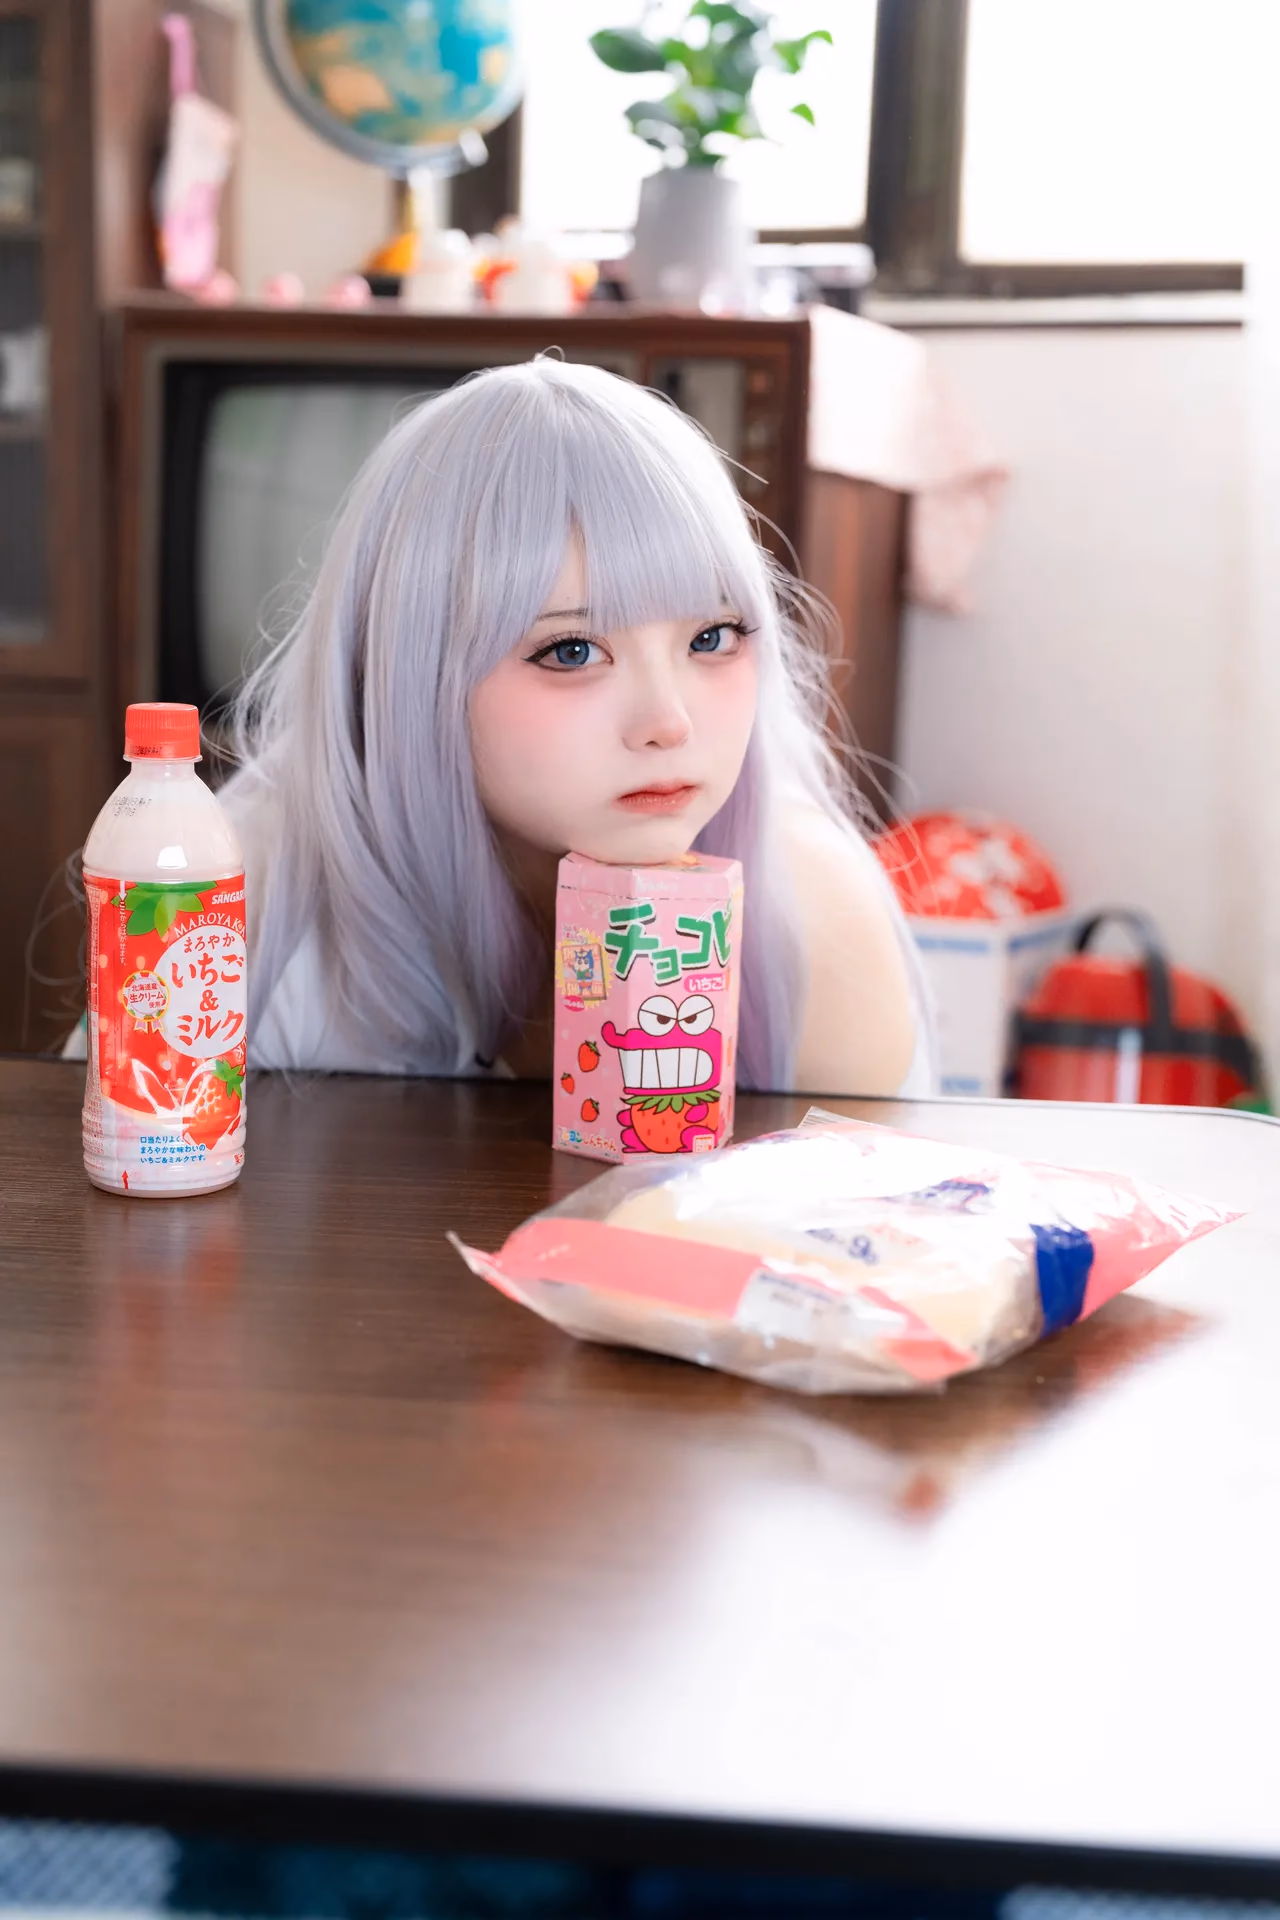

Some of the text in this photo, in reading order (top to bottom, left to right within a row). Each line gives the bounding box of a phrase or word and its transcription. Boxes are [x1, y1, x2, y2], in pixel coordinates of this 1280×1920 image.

[183, 932, 236, 954] まろやか
[171, 952, 245, 989] いちご
[129, 991, 165, 1004] 生クリーム
[131, 983, 158, 992] 北海道産
[199, 989, 219, 1012] &
[176, 1009, 244, 1047] ミルク
[139, 1143, 206, 1155] まろやかな味わいの
